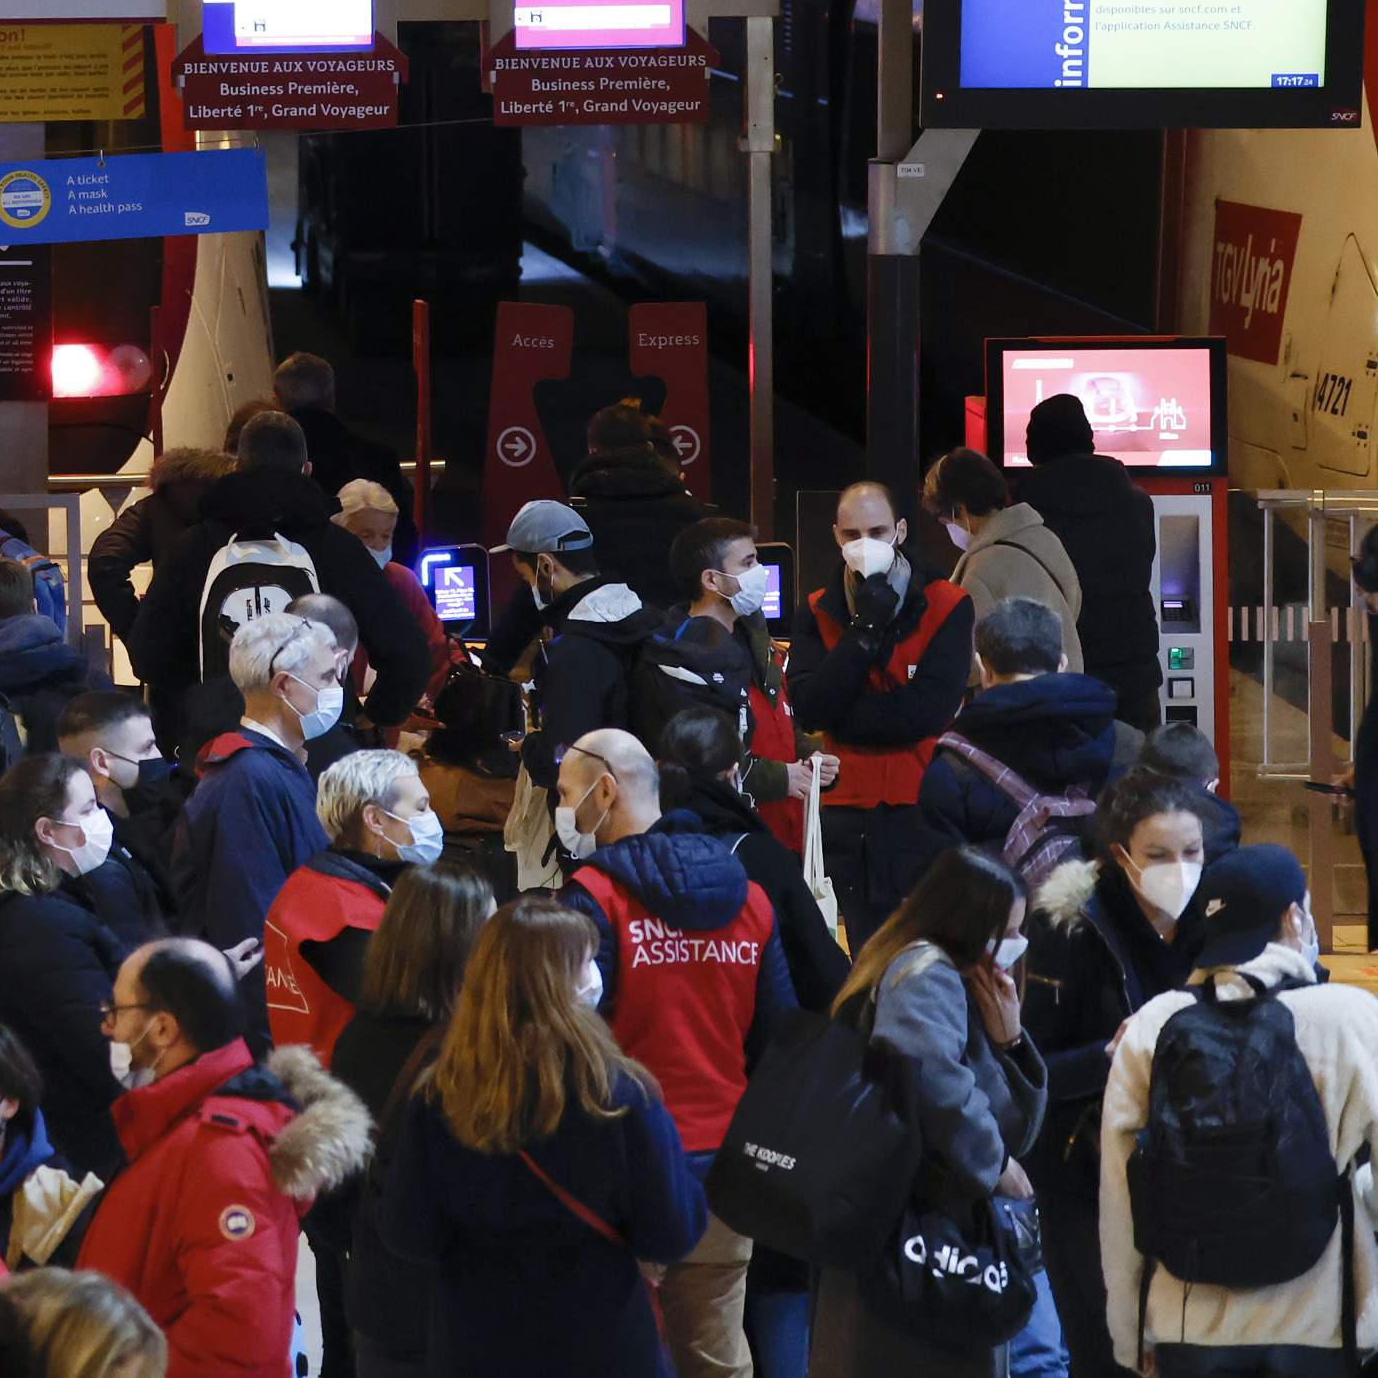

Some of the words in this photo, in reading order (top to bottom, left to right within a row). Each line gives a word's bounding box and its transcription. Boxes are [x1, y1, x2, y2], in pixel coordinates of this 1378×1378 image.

[1095, 5, 1156, 15] disponibles
[1179, 4, 1227, 14] sncf.com
[1230, 6, 1241, 14] et
[1095, 21, 1161, 32] l'application
[1163, 20, 1221, 30] Assistance
[1223, 21, 1256, 30] SNCF.
[184, 62, 269, 74] BIENVENUE
[273, 61, 303, 73] AUX
[307, 60, 395, 72] VOYAGEURS
[495, 57, 580, 70] BIENVENUE
[584, 56, 614, 68] AUX
[618, 55, 706, 68] VOYAGEURS
[532, 79, 595, 91] Business
[599, 77, 670, 92] Première,
[1277, 77, 1303, 85] 17:17
[220, 84, 284, 96] Business
[288, 82, 359, 96] Première,
[189, 106, 242, 118] Liberté
[271, 104, 317, 117] Grand
[321, 104, 390, 119] Voyageur
[501, 101, 553, 114] Liberté
[583, 99, 627, 113] Grand
[632, 99, 701, 114] Voyageur
[67, 176, 75, 185] A
[77, 174, 109, 185] ticket
[68, 190, 76, 200] A
[79, 188, 107, 199] mask
[69, 205, 77, 214] A
[79, 202, 115, 214] health
[118, 202, 142, 213] pass
[1217, 243, 1244, 304] TGV
[1240, 234, 1284, 329] Lyria
[513, 333, 554, 350] Accès
[638, 333, 699, 349] Express
[1317, 372, 1353, 417] 4721
[1194, 483, 1210, 492] 011
[632, 940, 759, 968] ASSISTANCE
[757, 1145, 796, 1170] KOOPLES
